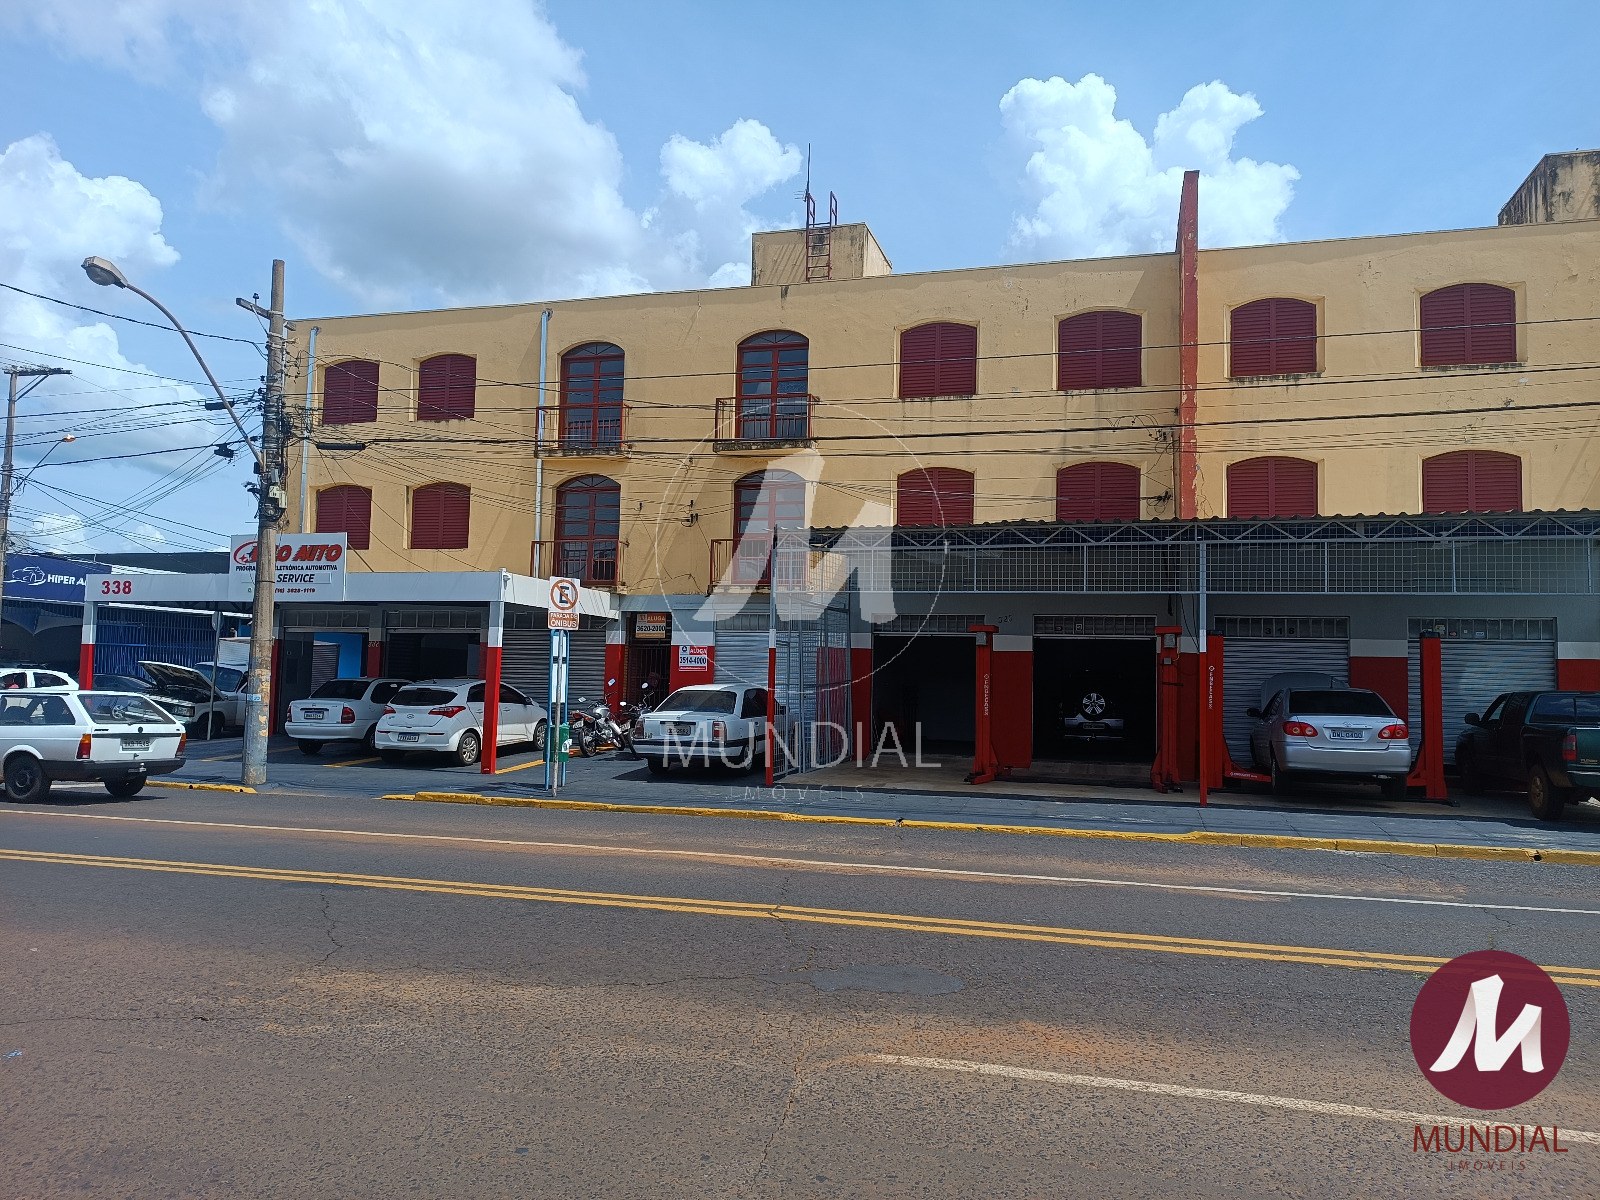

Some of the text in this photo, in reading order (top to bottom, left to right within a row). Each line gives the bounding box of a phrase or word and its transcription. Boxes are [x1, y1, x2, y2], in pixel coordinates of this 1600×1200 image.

[292, 543, 343, 562] AUTO
[47, 573, 75, 585] HIPER
[276, 573, 315, 583] SERVICE
[101, 580, 132, 595] 338
[550, 612, 578, 620] PARADA DE
[550, 619, 577, 628] ÔNIBUS
[689, 647, 707, 655] ALUGA
